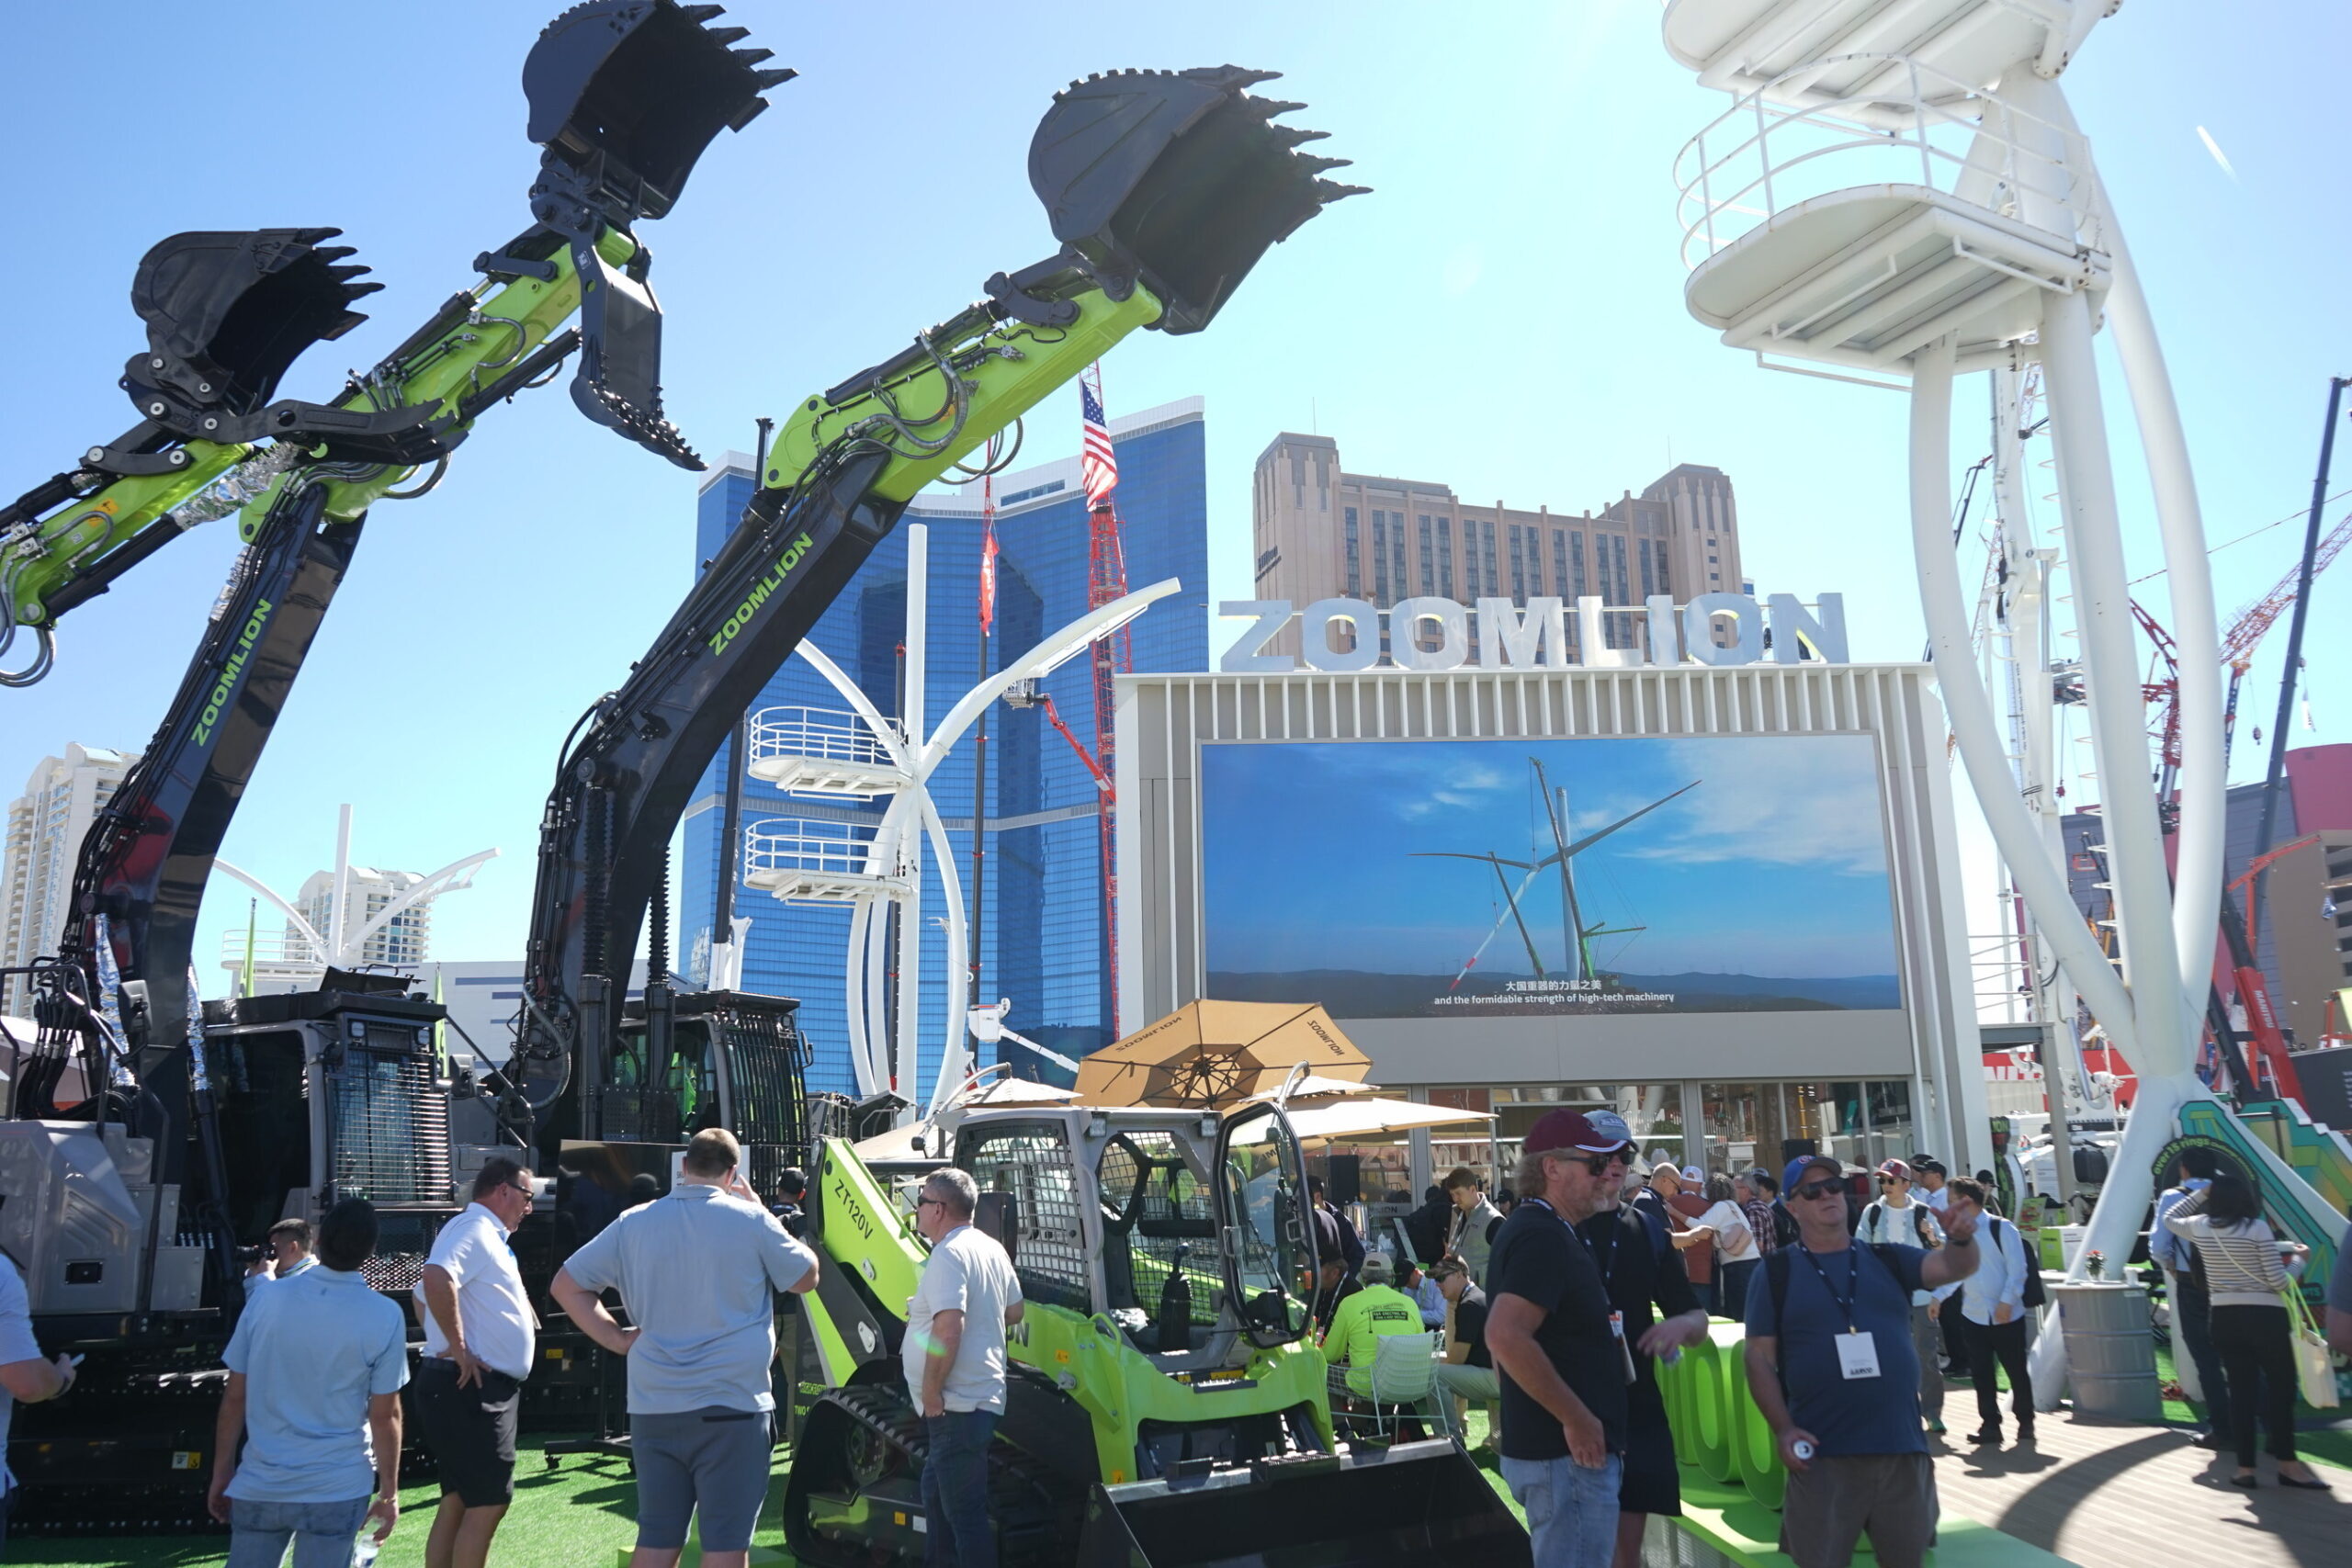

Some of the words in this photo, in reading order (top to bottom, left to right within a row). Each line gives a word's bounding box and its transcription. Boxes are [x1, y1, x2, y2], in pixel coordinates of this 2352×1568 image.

[708, 532, 814, 656] ZOOMLION
[1219, 592, 1850, 672] ZOOMLION
[190, 599, 273, 747] ZOOMLION
[1434, 995, 1453, 1005] and
[1454, 995, 1470, 1004] the
[1472, 994, 1522, 1004] formidable
[1525, 993, 1565, 1005] strength
[1566, 993, 1577, 1002] of
[1578, 992, 1623, 1004] high-tech
[1625, 992, 1674, 1004] machinery
[1505, 980, 1602, 992] 大国重器的力量之美
[2254, 990, 2275, 1028] MANITOU
[2153, 1153, 2169, 1175] over
[2166, 1141, 2180, 1154] 15
[2181, 1138, 2210, 1147] rings
[834, 1179, 873, 1239] ZT120V
